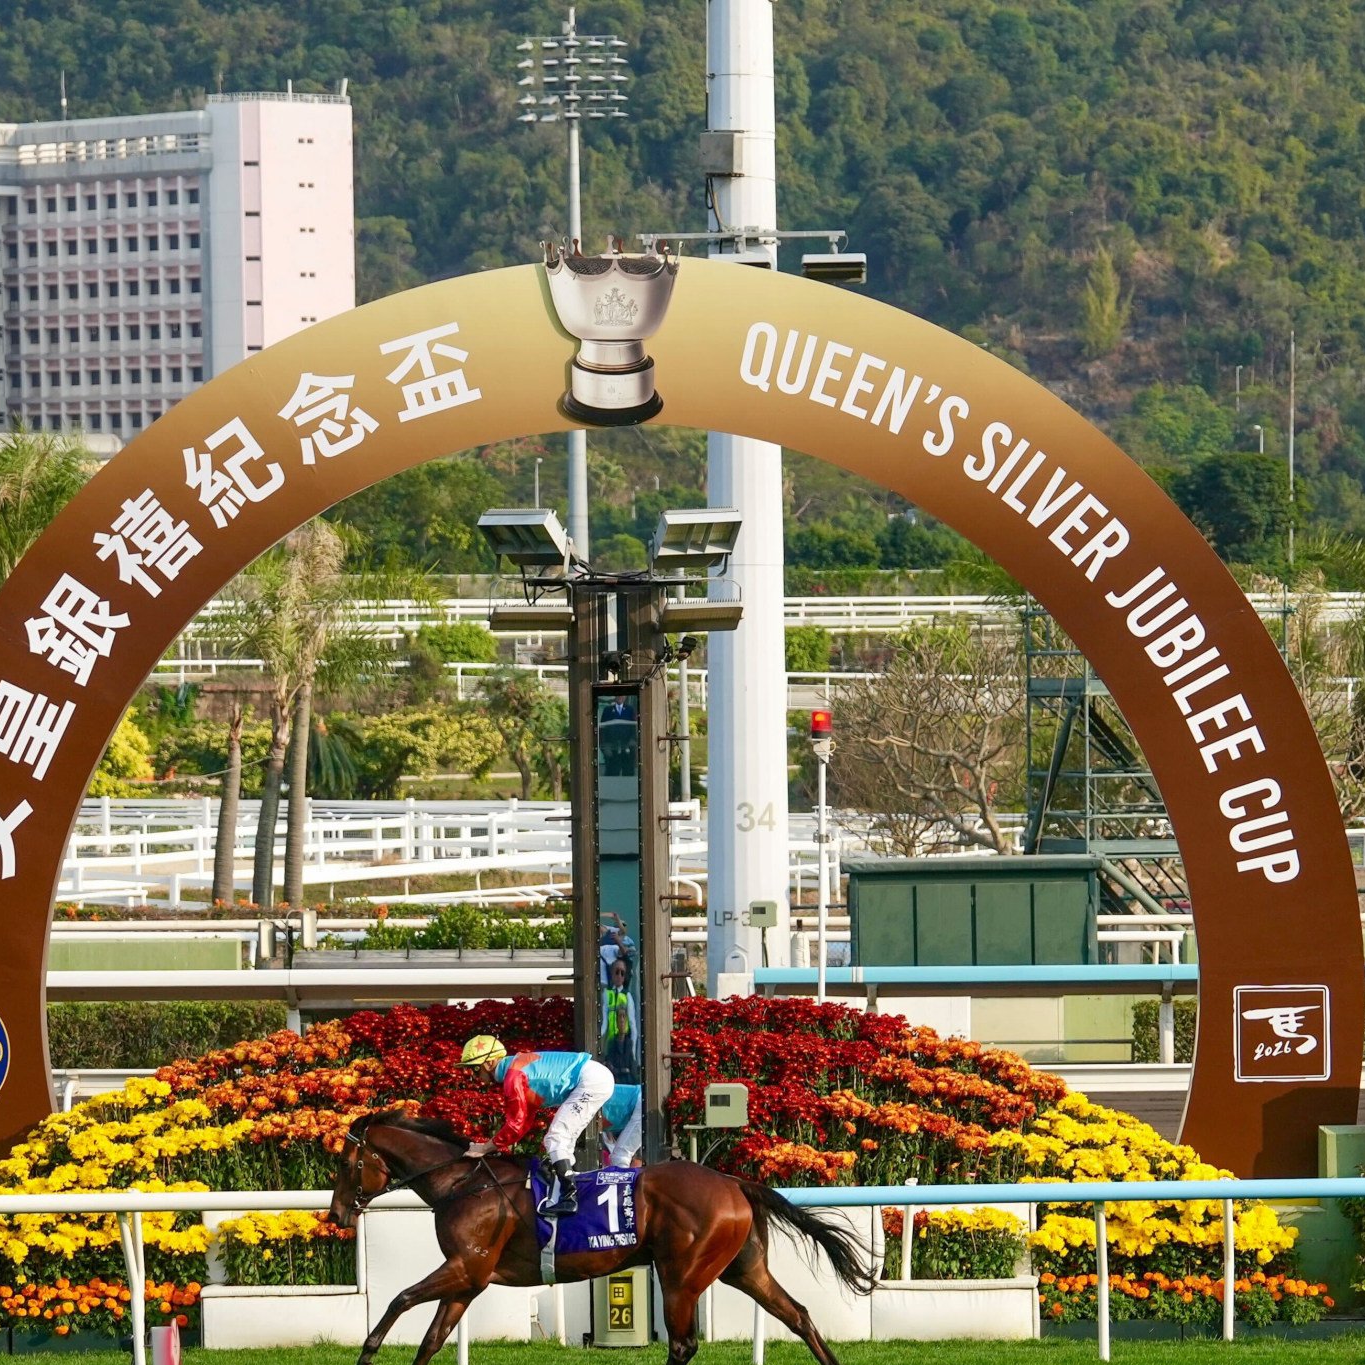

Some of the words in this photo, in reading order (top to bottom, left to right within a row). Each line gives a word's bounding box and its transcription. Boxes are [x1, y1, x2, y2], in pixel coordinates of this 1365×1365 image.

[739, 321, 970, 457] QUEEN'S
[963, 420, 1131, 583] SILVER
[1105, 566, 1267, 774] JUBILEE
[1219, 777, 1302, 884] CUP
[736, 801, 777, 833] 34
[1252, 1040, 1293, 1061] 2026
[597, 1183, 621, 1233] 1
[610, 1307, 633, 1325] 26
